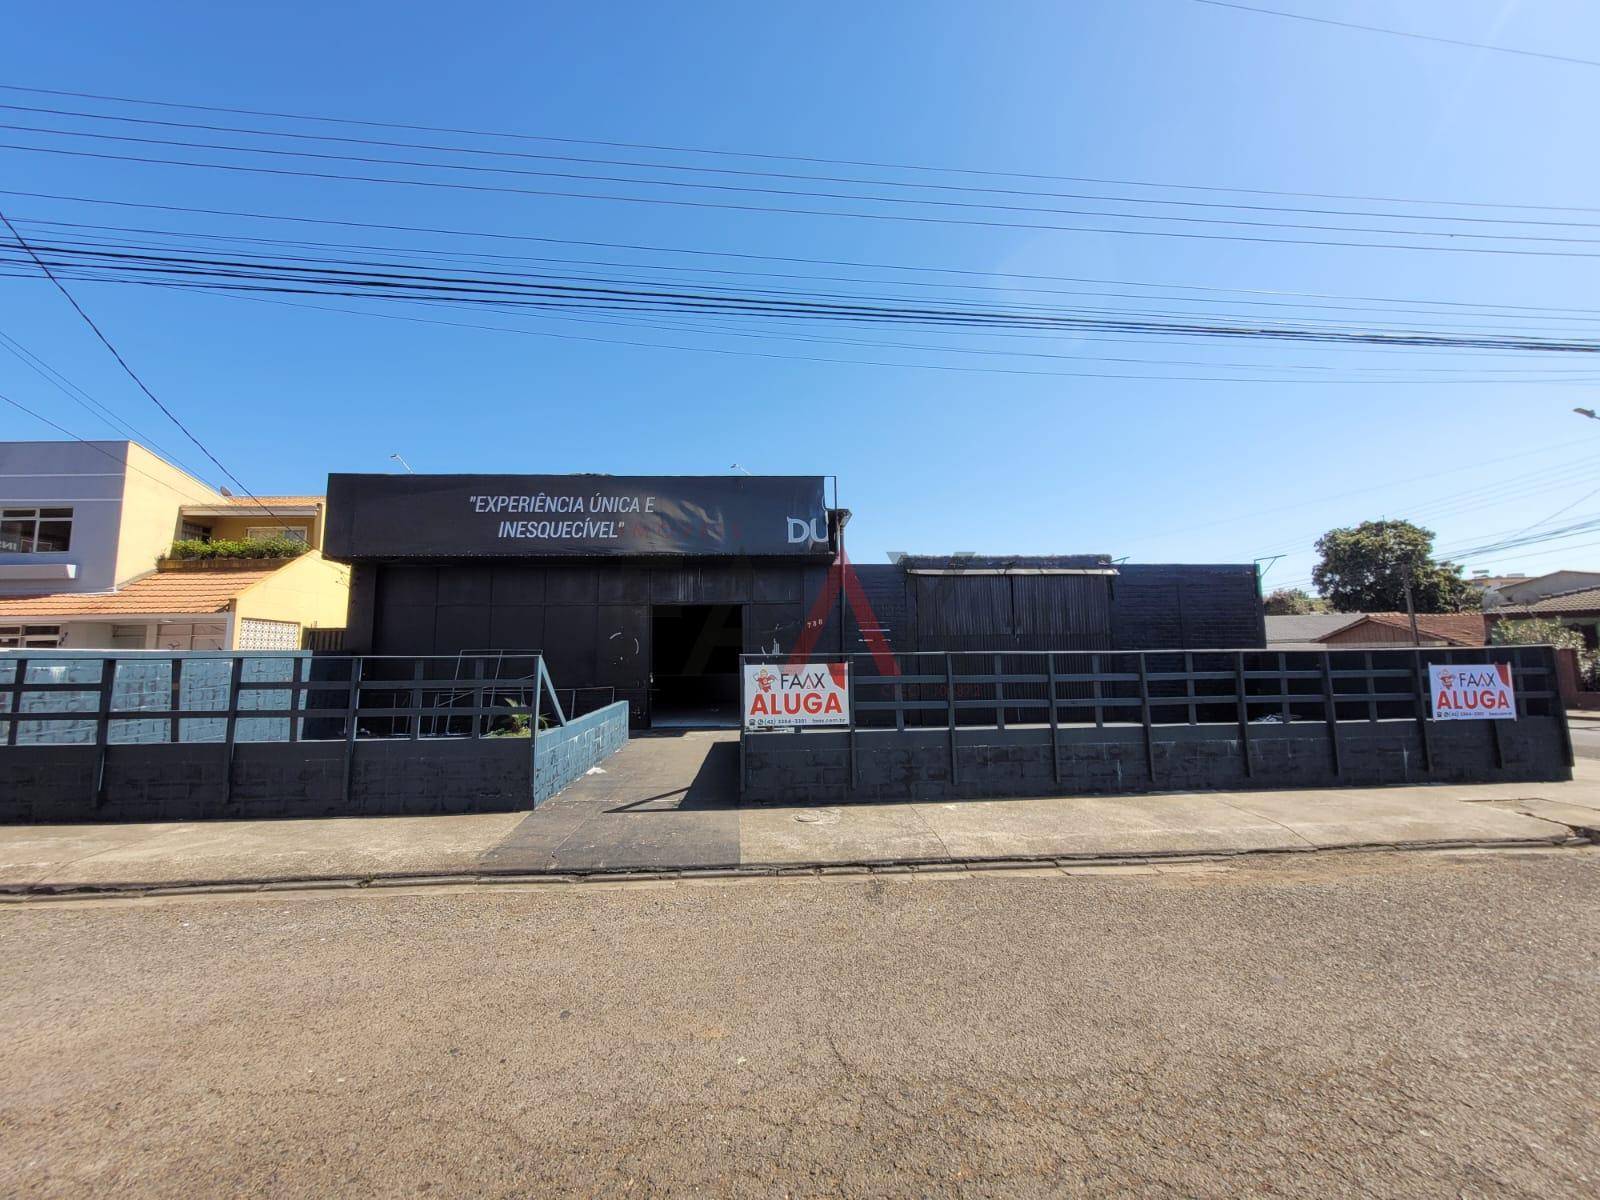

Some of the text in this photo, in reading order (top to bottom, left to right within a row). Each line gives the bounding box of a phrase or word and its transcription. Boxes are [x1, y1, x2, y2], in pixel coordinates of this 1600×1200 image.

[469, 492, 656, 513] "EXPERIÊNCIA ÚNICA E
[498, 517, 625, 539] INESQUECÍVEL"
[750, 692, 843, 716] ALUGA
[1437, 690, 1510, 710] ALUGA
